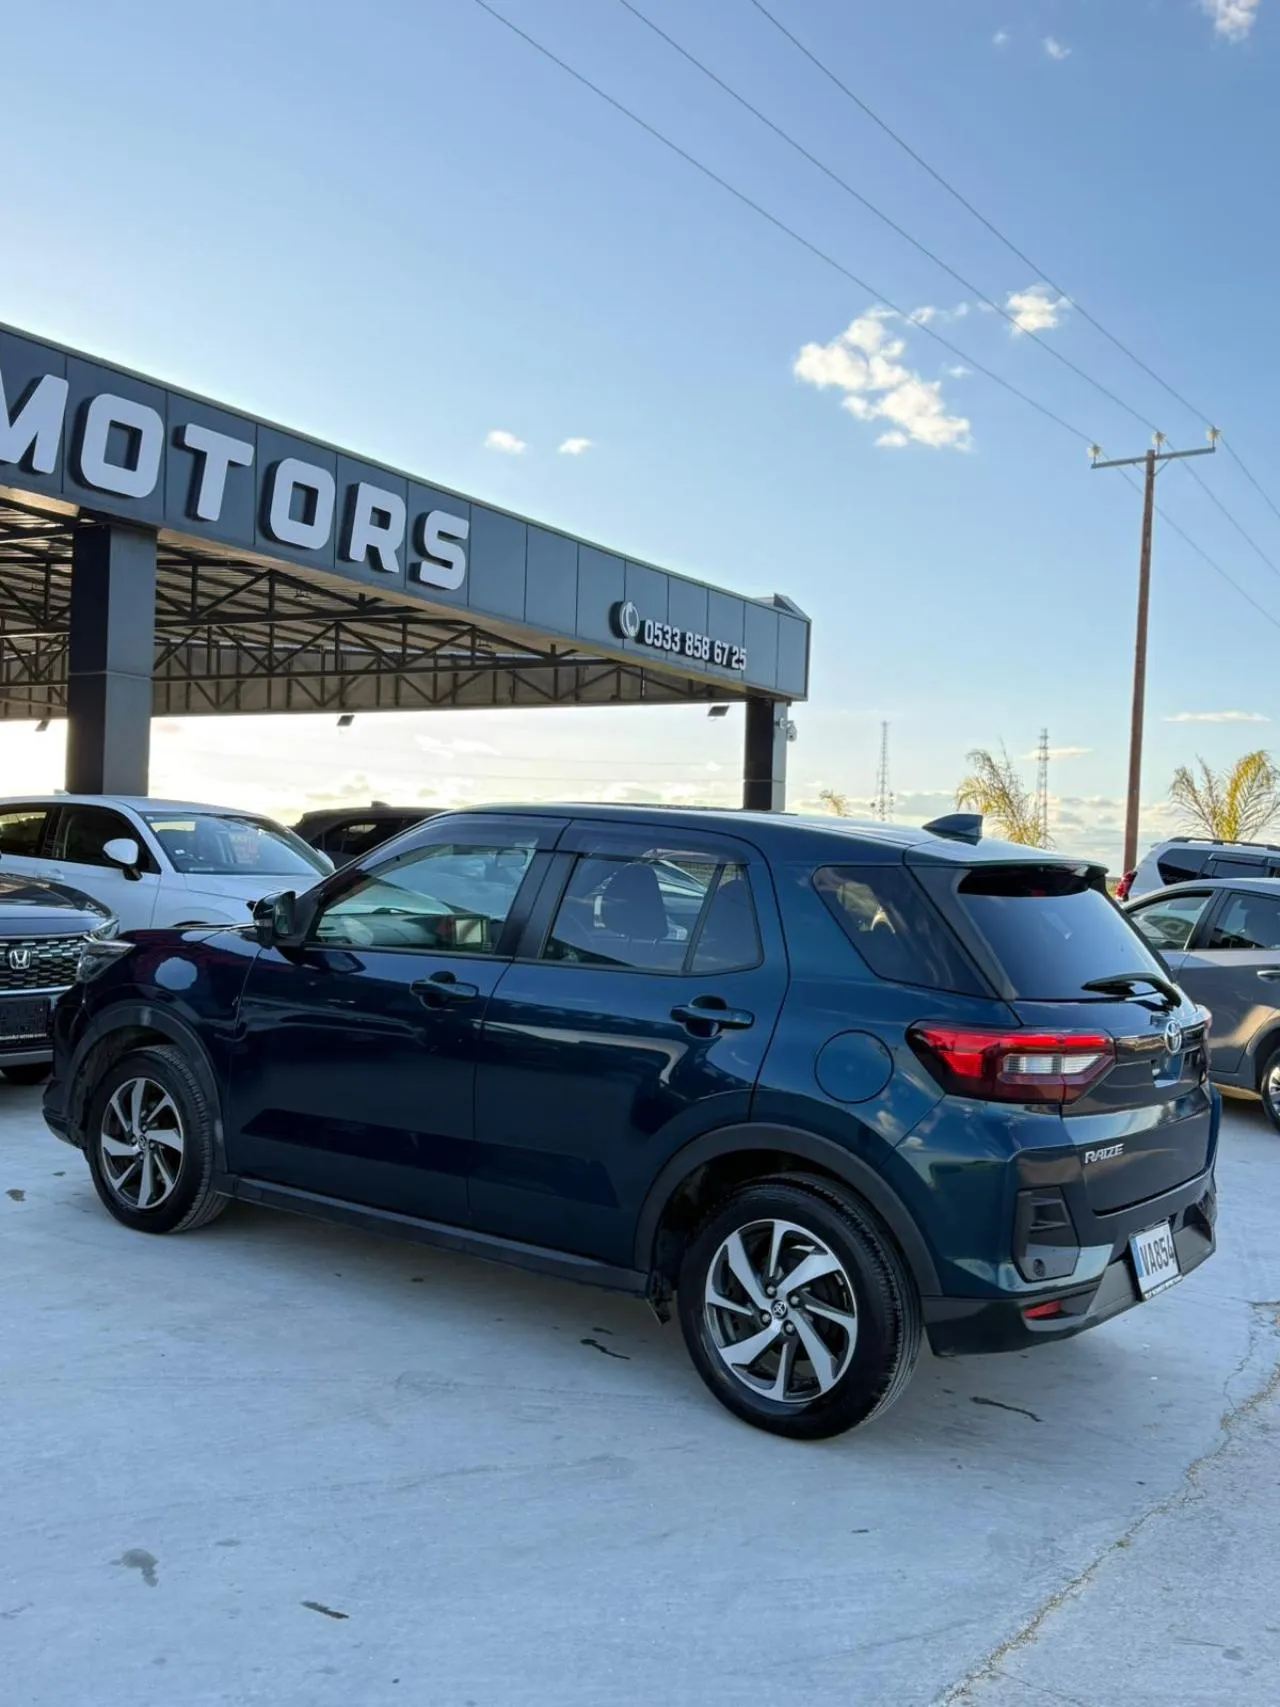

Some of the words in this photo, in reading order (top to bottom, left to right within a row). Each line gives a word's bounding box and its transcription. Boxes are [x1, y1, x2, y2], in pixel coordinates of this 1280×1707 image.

[0, 369, 470, 591] MOTORS
[644, 619, 681, 652] 0533
[685, 631, 710, 660] 858
[713, 640, 729, 666] 67
[731, 646, 747, 671] 25
[1084, 1143, 1125, 1164] RAIZE
